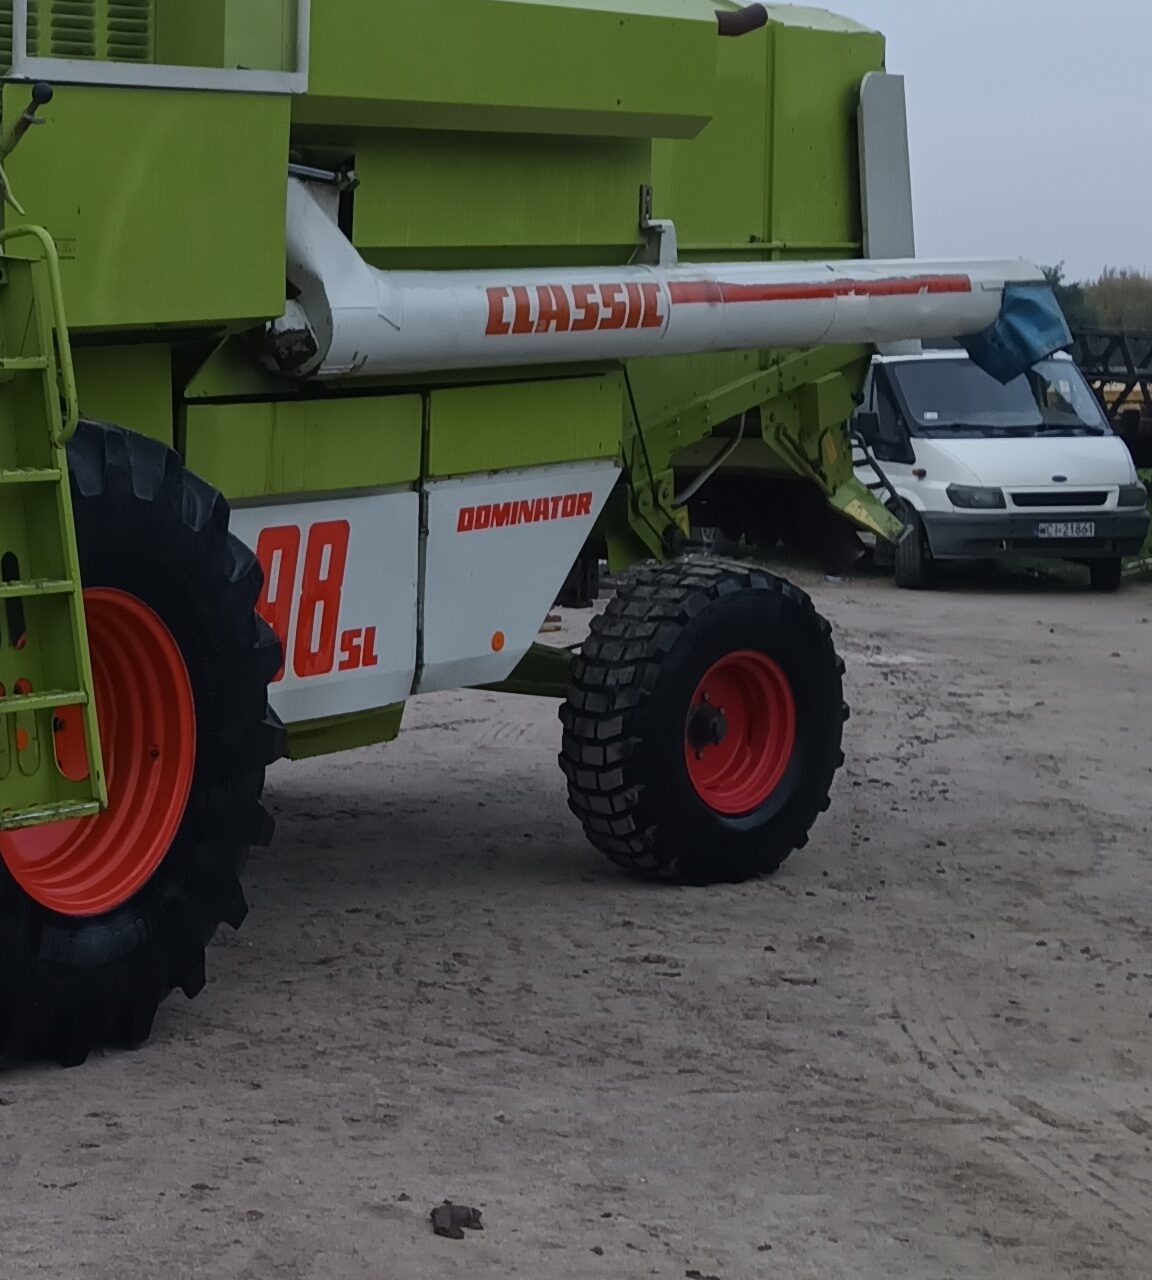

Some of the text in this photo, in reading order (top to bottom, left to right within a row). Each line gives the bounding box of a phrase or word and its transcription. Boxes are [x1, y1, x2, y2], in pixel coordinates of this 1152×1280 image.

[485, 282, 665, 336] CLASSIC
[456, 491, 593, 533] DOMINATOR
[256, 520, 378, 683] 98 SL
